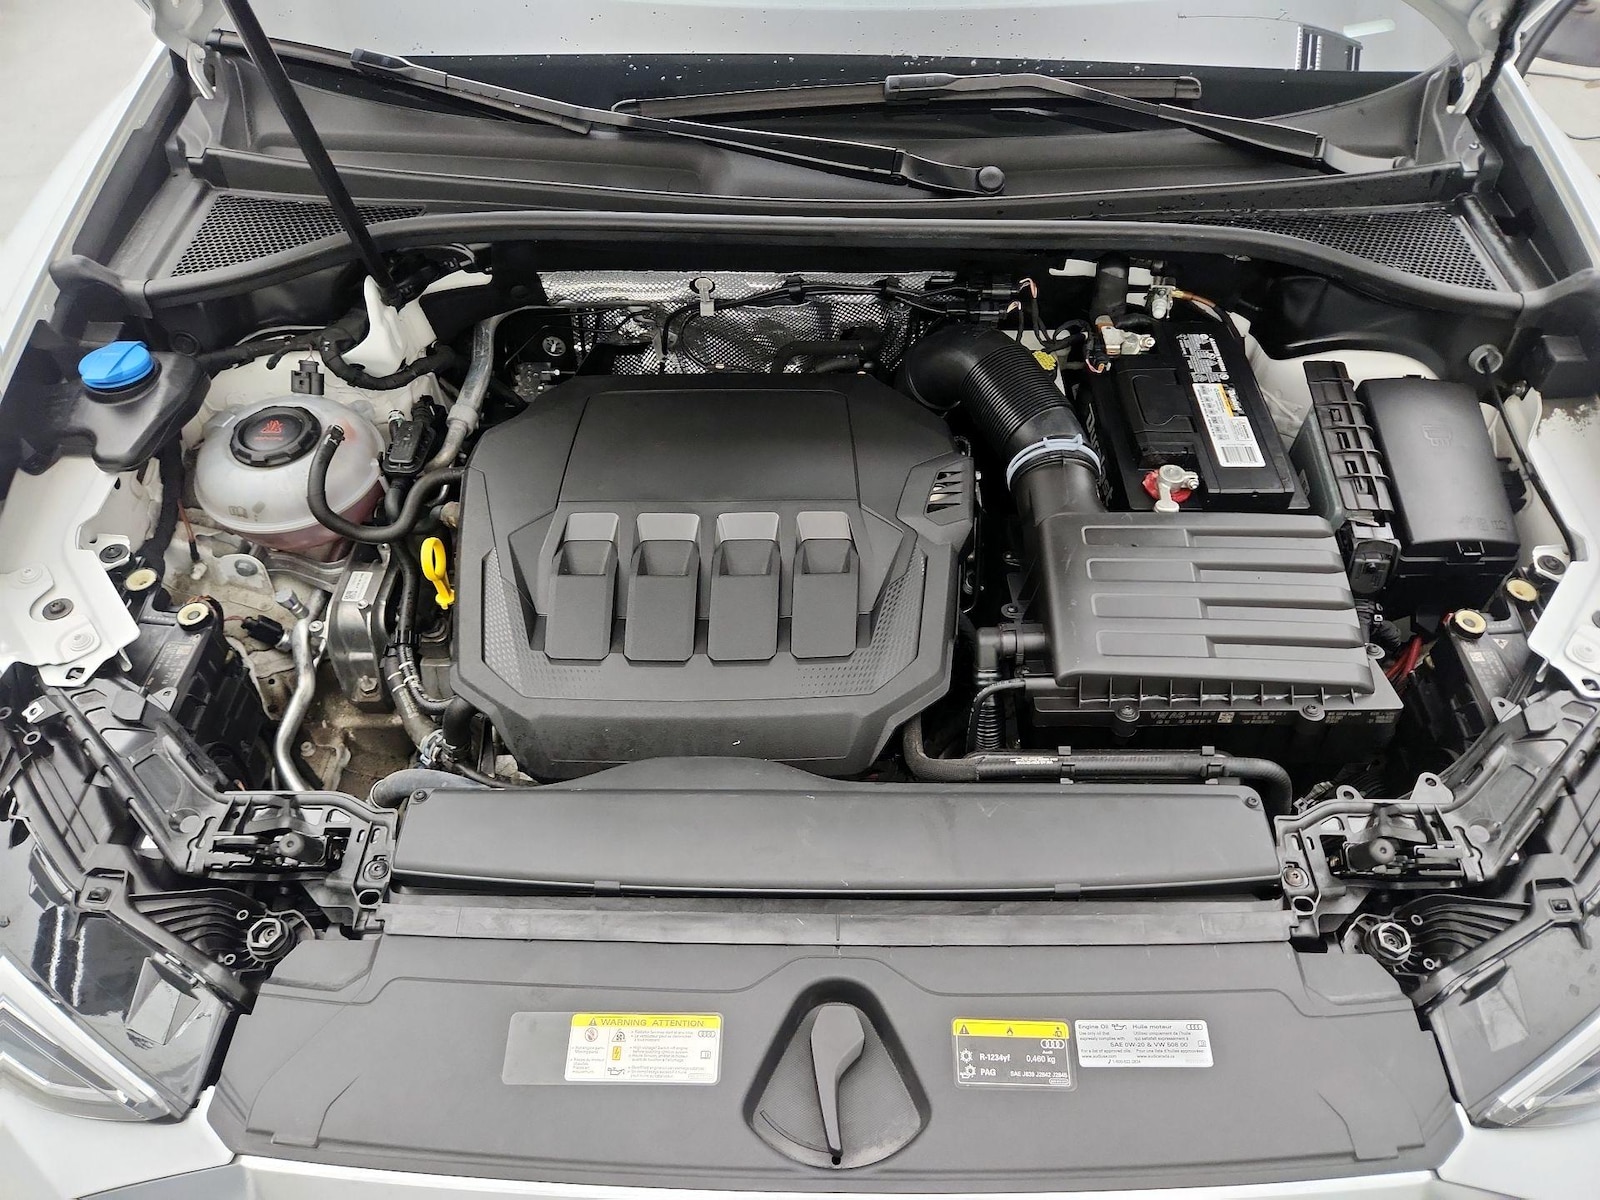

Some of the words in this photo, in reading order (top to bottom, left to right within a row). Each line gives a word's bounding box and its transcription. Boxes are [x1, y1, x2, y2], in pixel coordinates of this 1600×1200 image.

[600, 1018, 647, 1026] WARNING
[652, 1019, 705, 1027] ATTENTION
[979, 1053, 1011, 1062] R-1234yf
[1026, 1055, 1046, 1063] 0,460
[1047, 1055, 1056, 1064] kg
[980, 1068, 996, 1076] PAG
